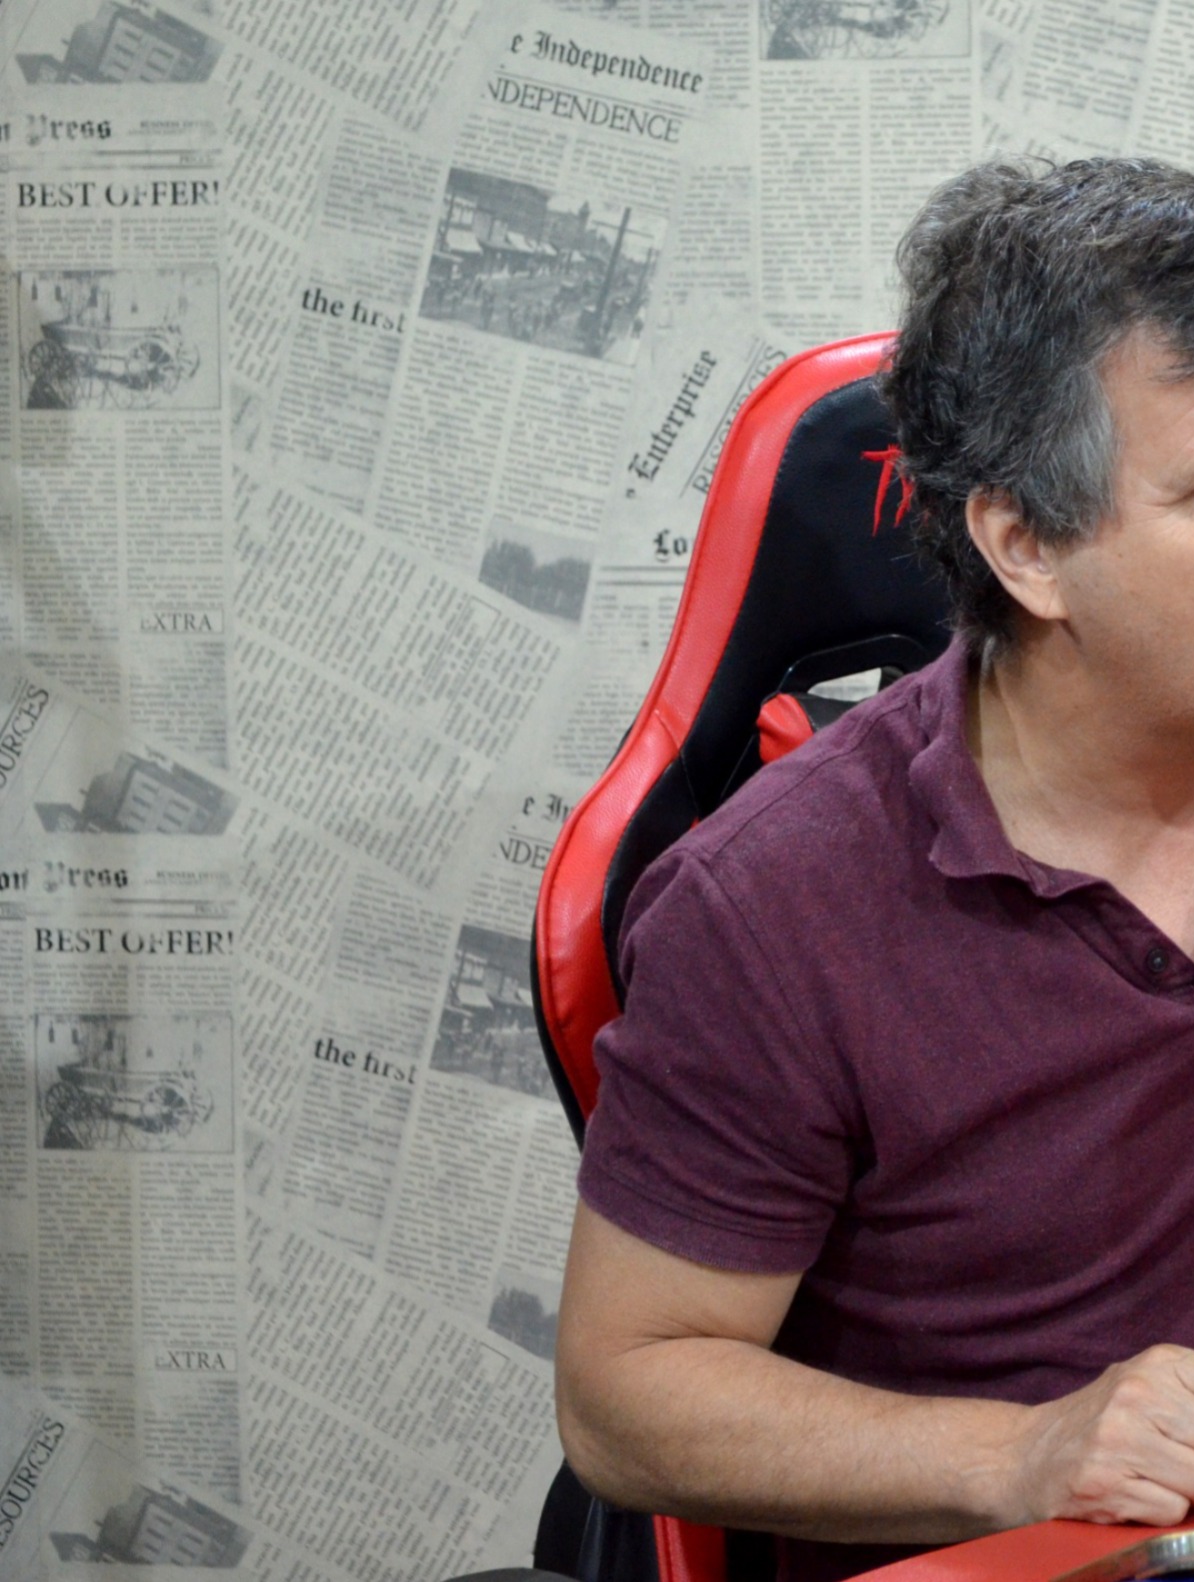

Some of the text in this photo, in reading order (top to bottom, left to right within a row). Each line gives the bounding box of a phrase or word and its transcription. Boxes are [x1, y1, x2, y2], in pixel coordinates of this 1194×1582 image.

[529, 29, 703, 94] Independence
[17, 180, 219, 208] BEST OFFER!
[301, 287, 405, 334] the first
[627, 350, 717, 482] Enterprise
[140, 612, 213, 632] EXTRA
[35, 927, 234, 955] BEST OFFER!
[313, 1035, 418, 1085] the first
